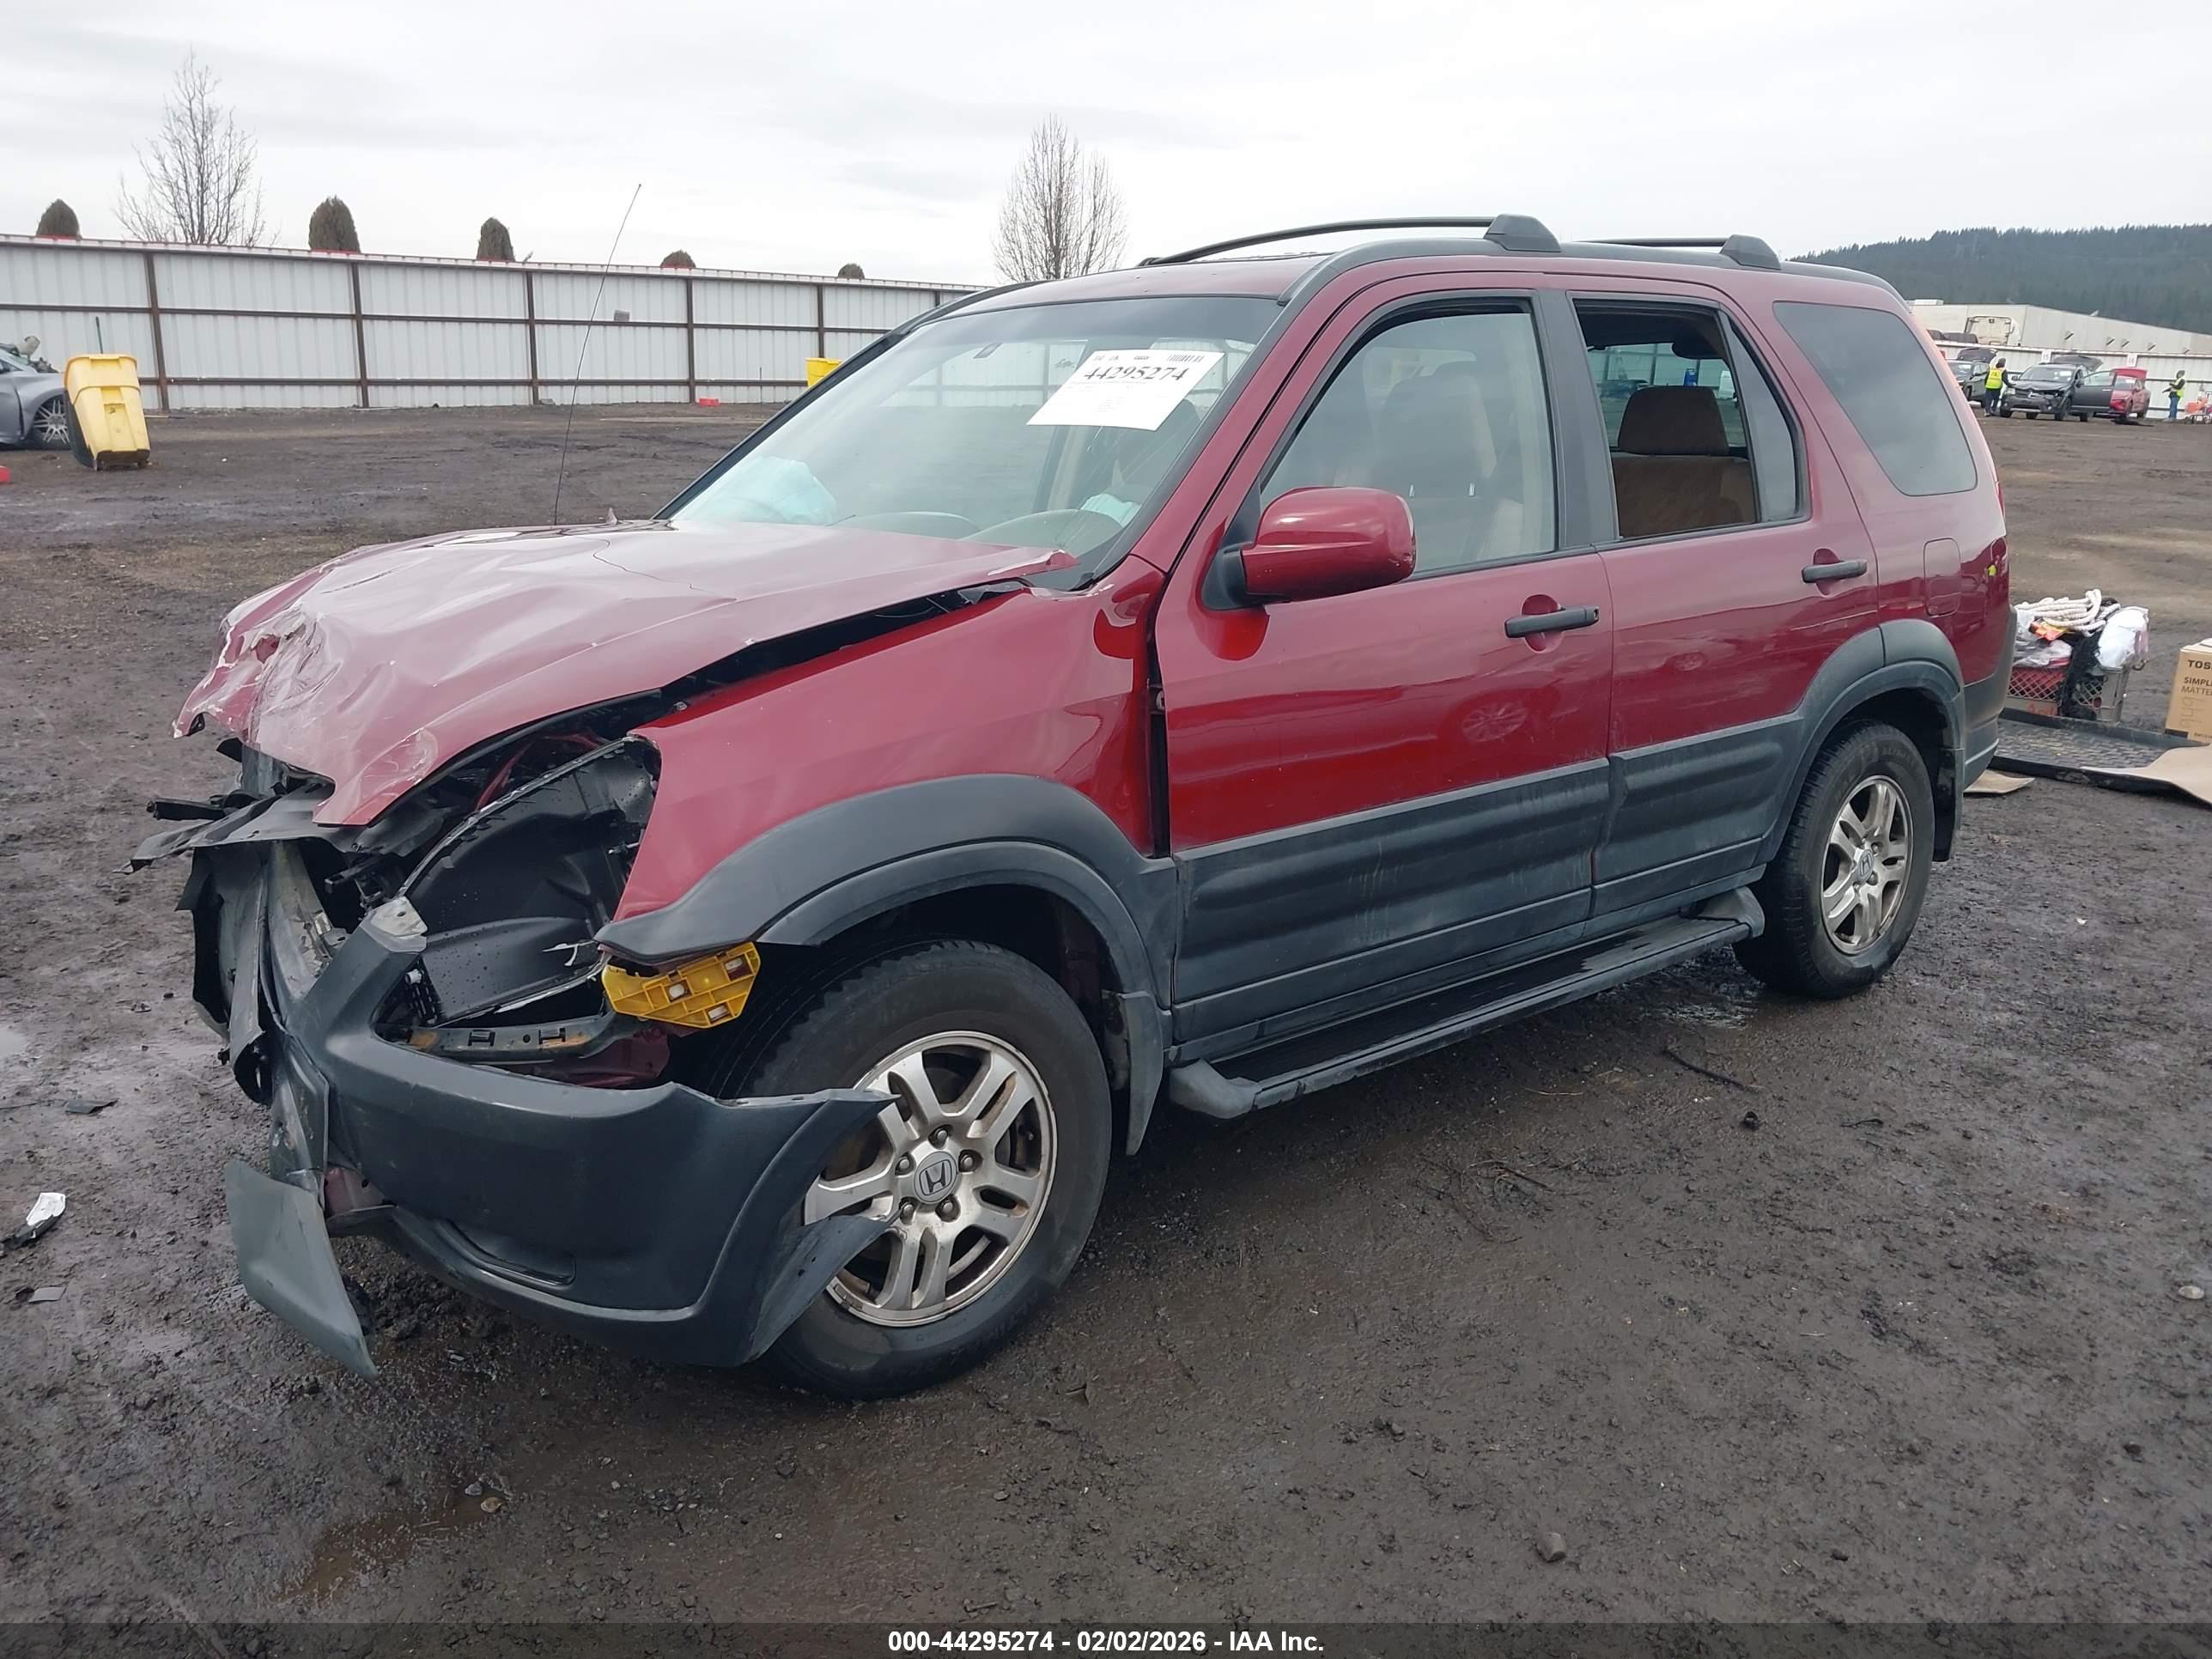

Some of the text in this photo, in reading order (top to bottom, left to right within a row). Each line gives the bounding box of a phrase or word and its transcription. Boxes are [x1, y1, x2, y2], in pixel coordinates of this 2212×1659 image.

[1084, 366, 1189, 380] 44295274
[2187, 659, 2212, 670] TOS
[2184, 676, 2212, 687] SIMPL
[2181, 685, 2212, 696] MATTE
